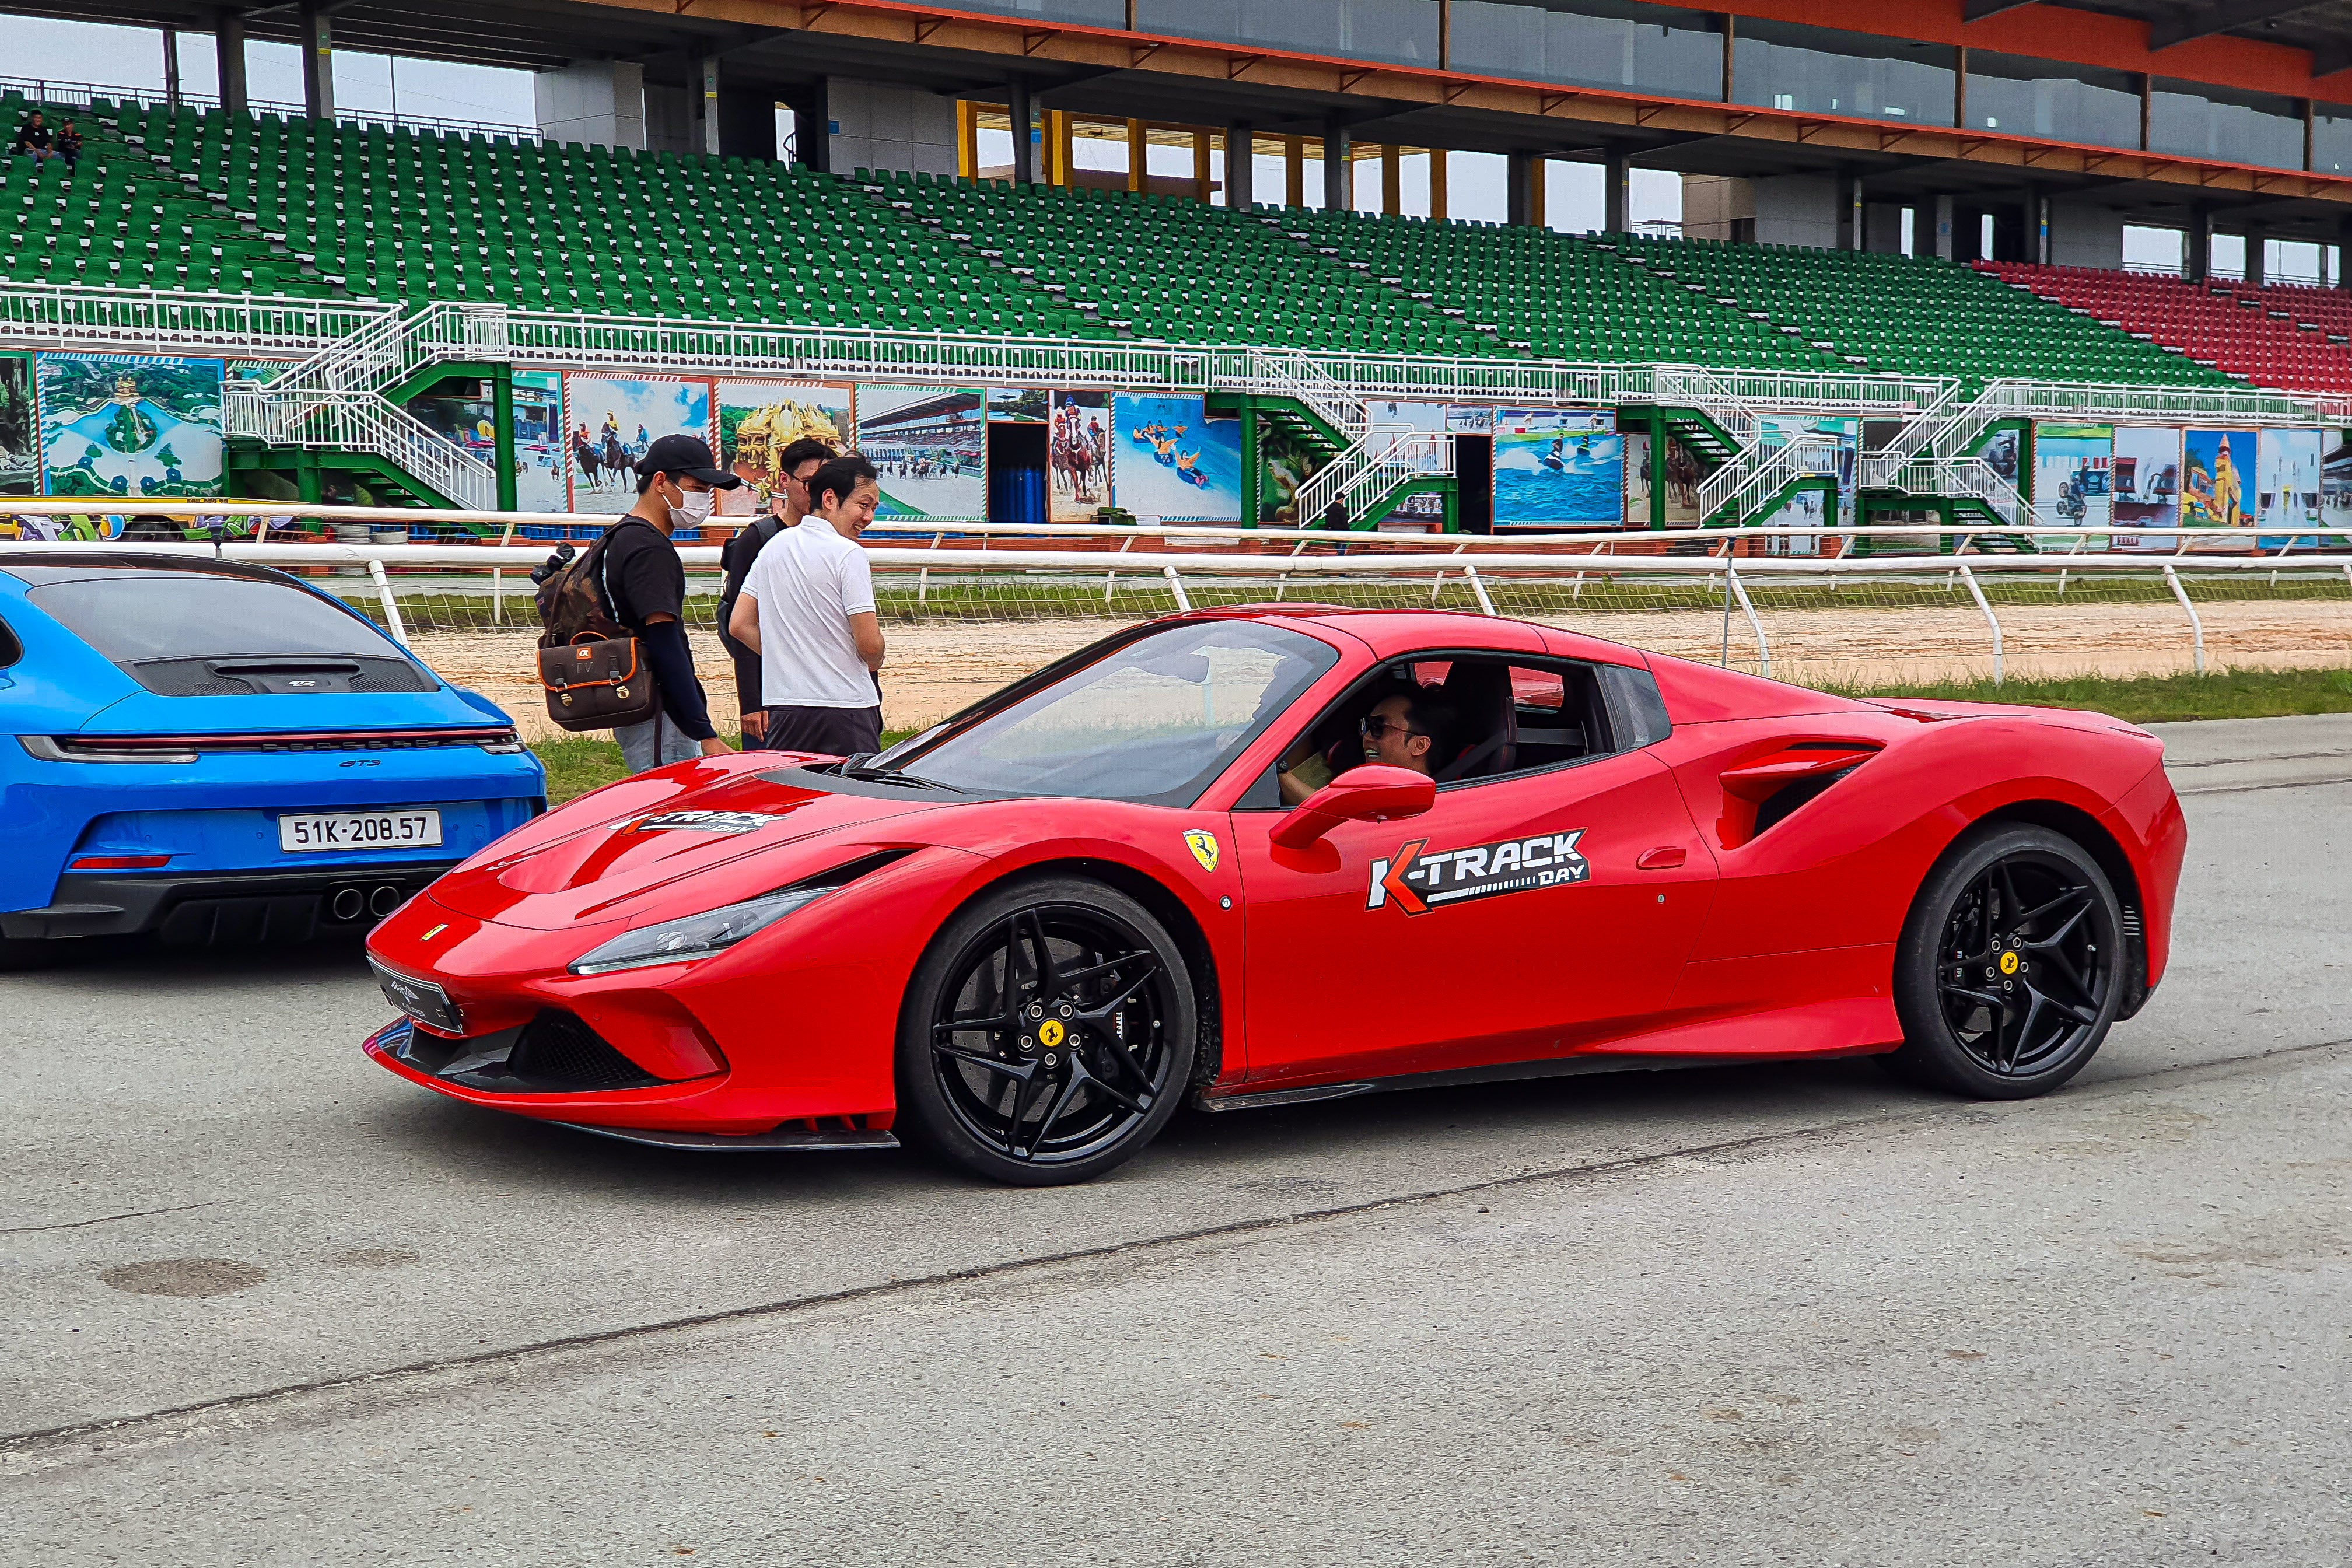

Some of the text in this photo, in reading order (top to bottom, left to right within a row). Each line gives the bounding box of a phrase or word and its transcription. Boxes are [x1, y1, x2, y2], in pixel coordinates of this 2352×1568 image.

[262, 740, 430, 751] PORSCHE
[338, 759, 382, 767] GT3
[293, 817, 426, 844] 51K-208.57
[1368, 832, 1583, 913] K-TRACK
[1539, 864, 1584, 885] DAY
